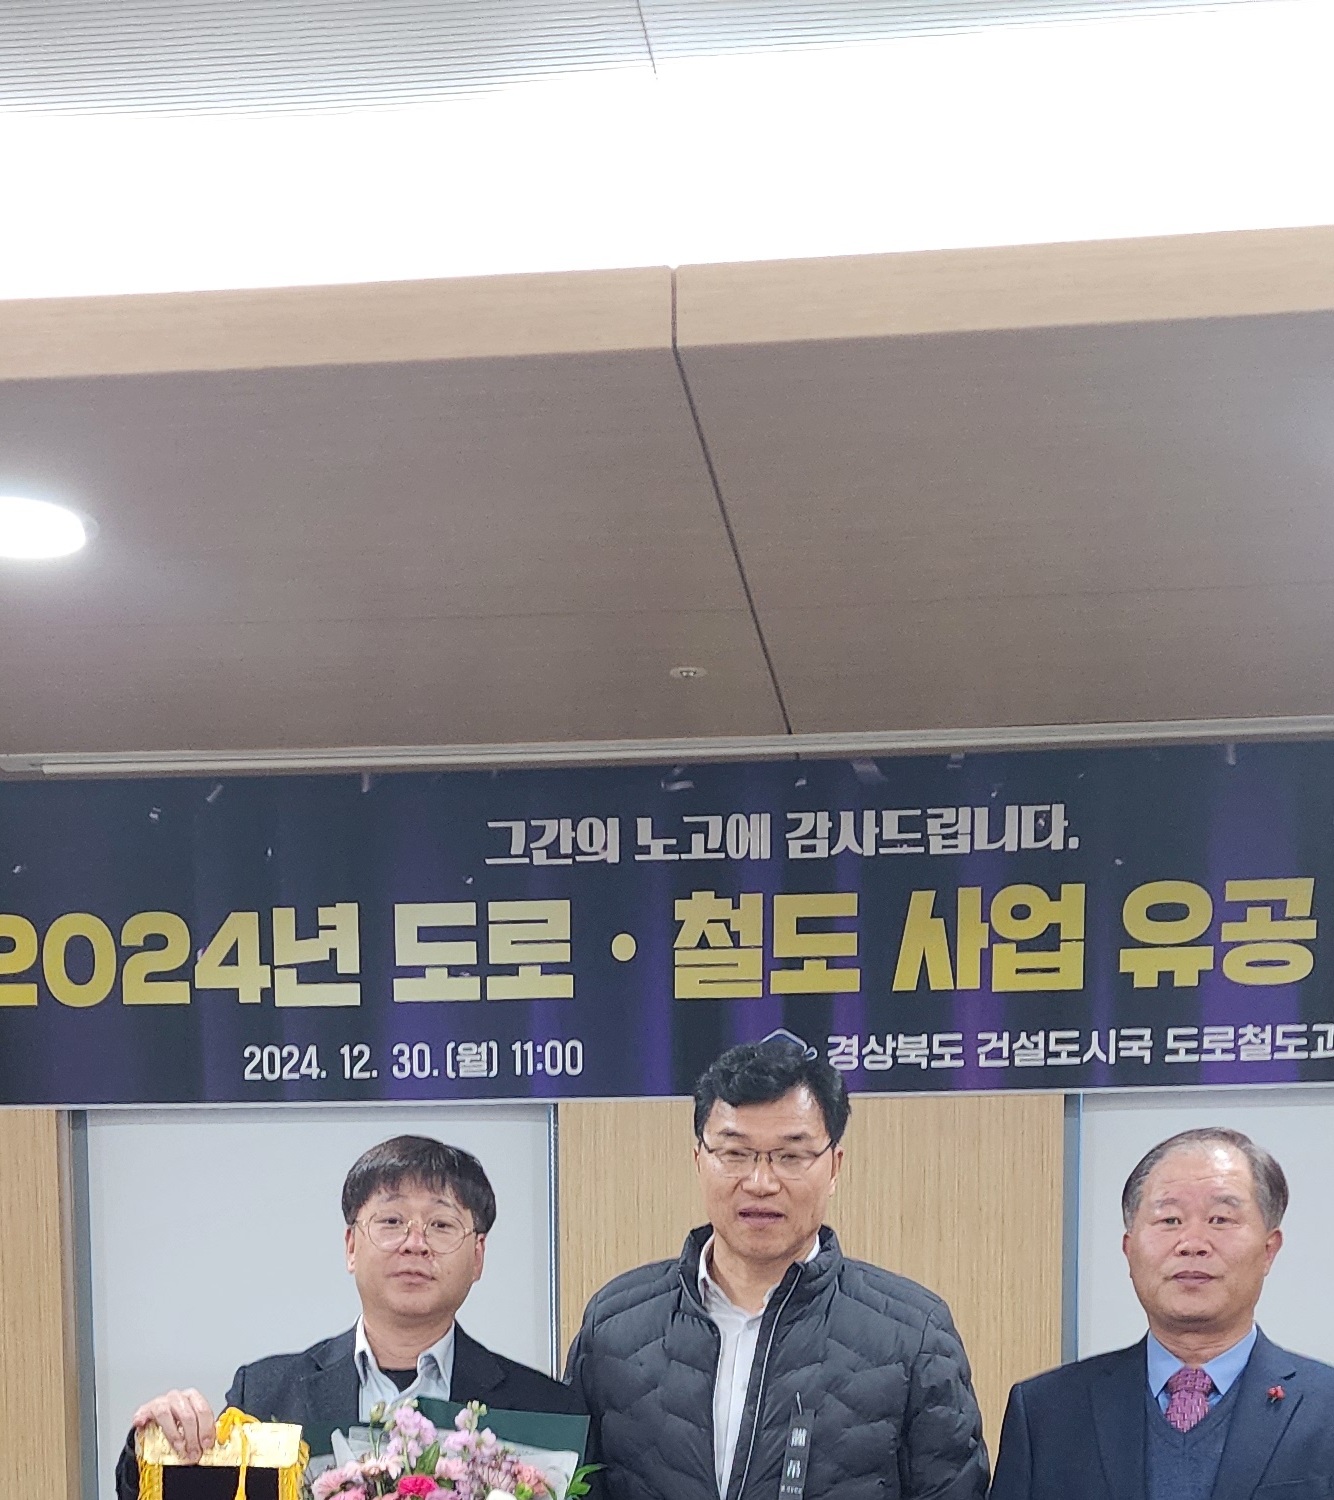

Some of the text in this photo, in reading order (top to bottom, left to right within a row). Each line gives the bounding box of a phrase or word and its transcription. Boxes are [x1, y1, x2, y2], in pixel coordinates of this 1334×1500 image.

[485, 803, 1081, 865] 그간의 노고에 감사드립니다.
[392, 899, 574, 1003] 도로
[673, 890, 861, 999] 철도
[891, 883, 1086, 993] 사업
[1119, 876, 1318, 988] 유공
[242, 1044, 327, 1081] 2024.
[340, 1044, 378, 1080] 12.
[511, 1038, 584, 1076] 11:00
[827, 1031, 965, 1071] 경상북도
[976, 1026, 1153, 1068] 건설도시국
